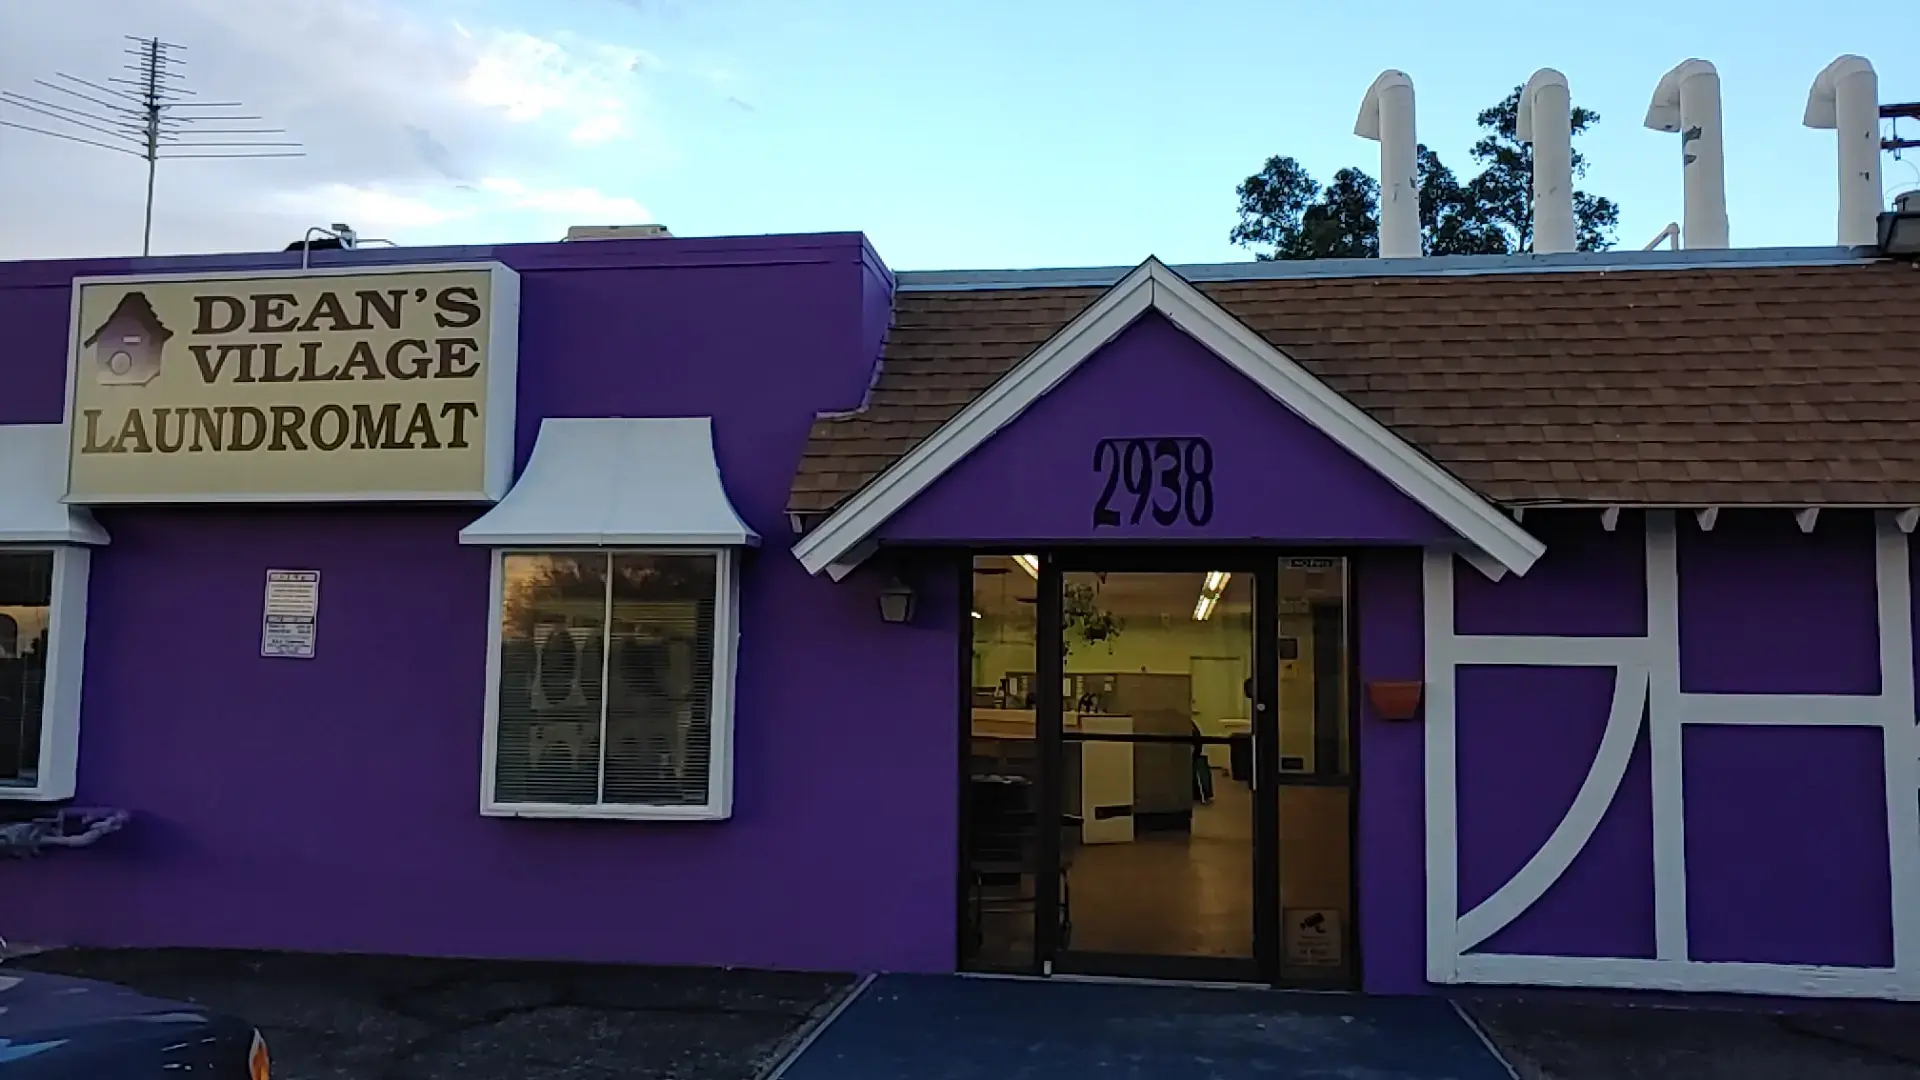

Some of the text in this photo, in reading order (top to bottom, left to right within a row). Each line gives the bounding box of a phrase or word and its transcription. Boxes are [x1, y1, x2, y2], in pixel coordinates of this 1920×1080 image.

[192, 287, 481, 334] DEAN'S
[188, 338, 480, 382] VILLAGE
[81, 403, 479, 453] LAUNDROMAT
[1093, 437, 1213, 527] 2938
